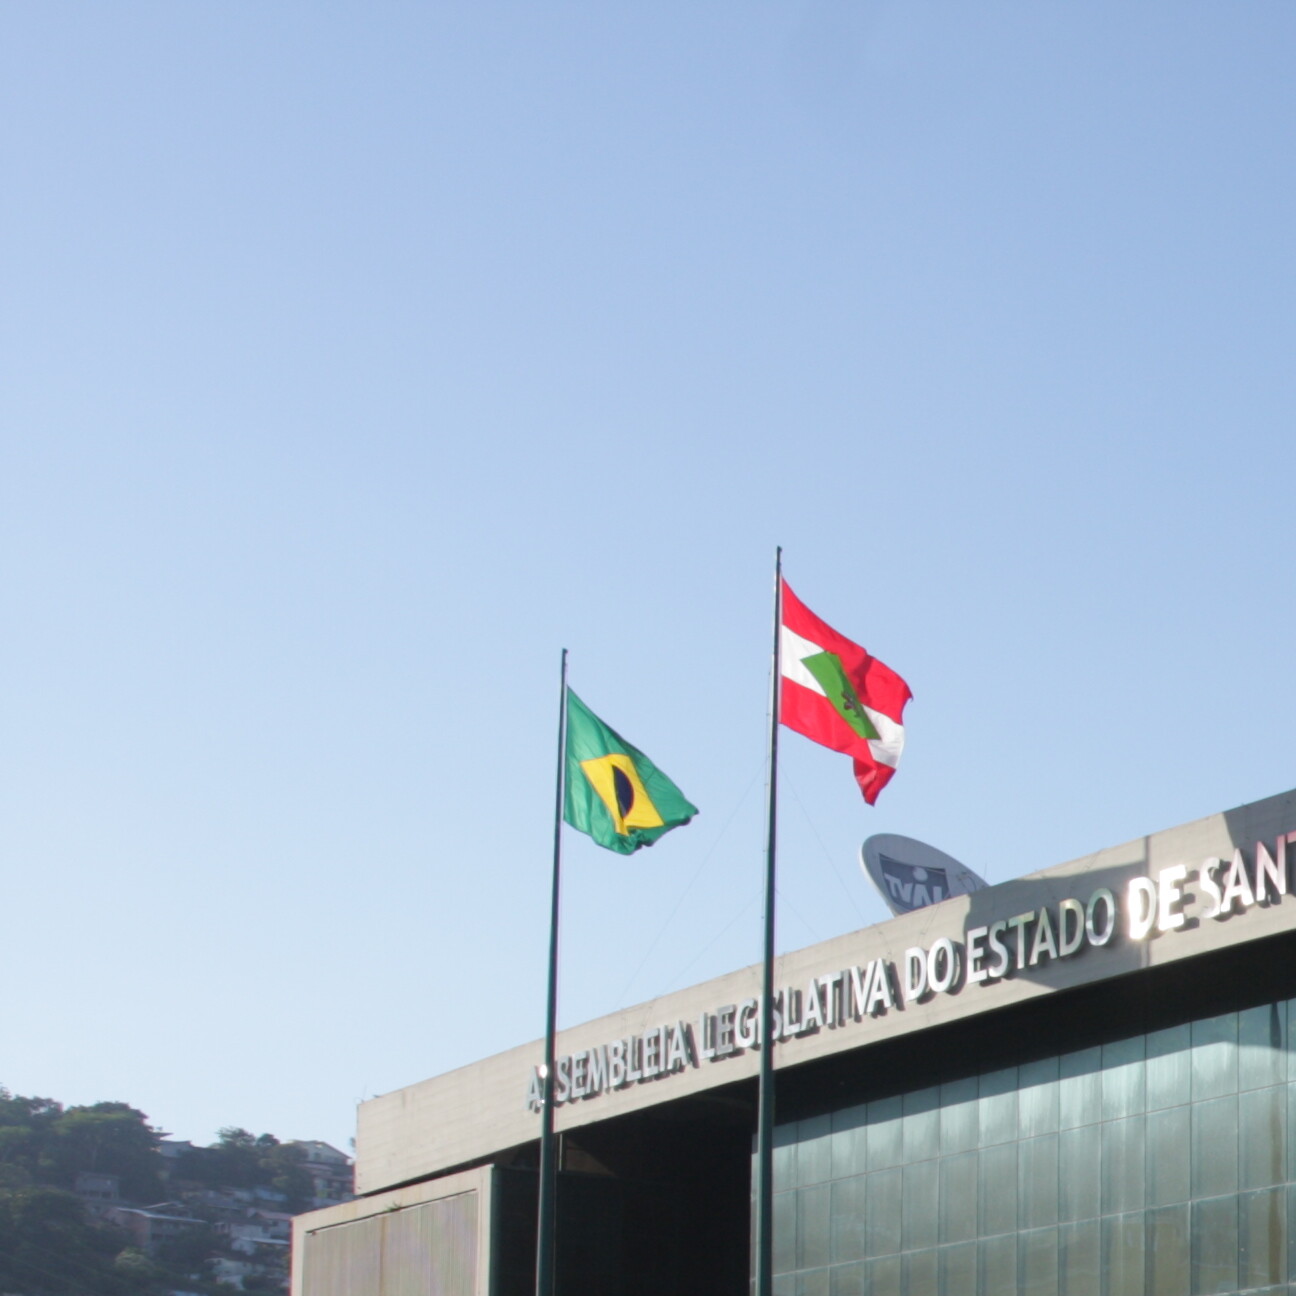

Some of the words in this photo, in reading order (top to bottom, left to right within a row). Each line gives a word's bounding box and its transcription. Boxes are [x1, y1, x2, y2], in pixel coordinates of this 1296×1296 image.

[524, 1020, 688, 1110] ASEMBLEIA
[700, 958, 892, 1059] LEGISLATIVA
[904, 937, 955, 1001] DO
[967, 888, 1115, 984] ESTADO
[1127, 864, 1187, 940] DE
